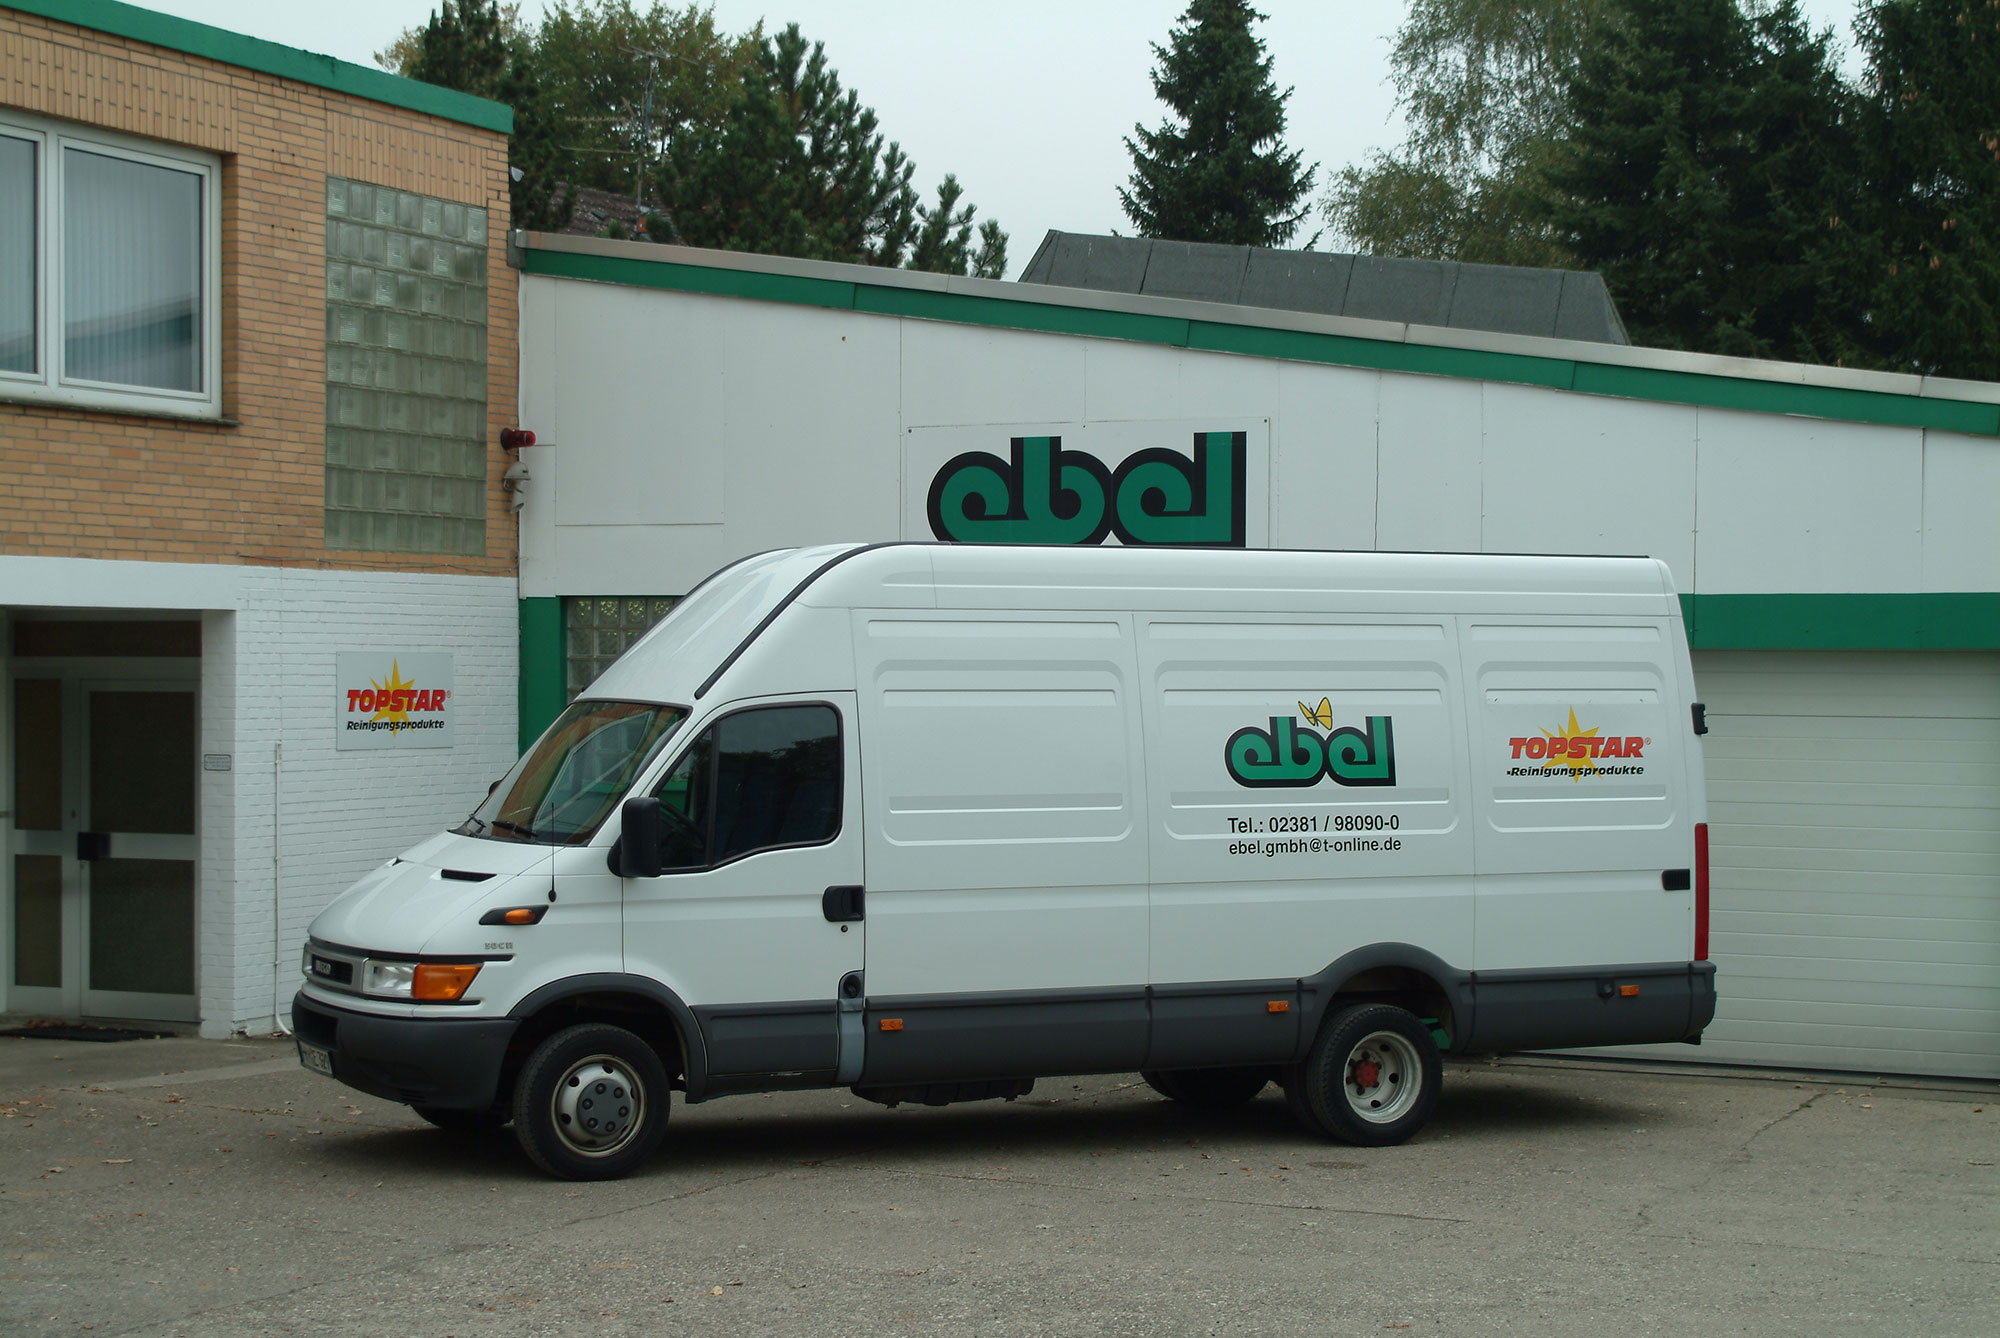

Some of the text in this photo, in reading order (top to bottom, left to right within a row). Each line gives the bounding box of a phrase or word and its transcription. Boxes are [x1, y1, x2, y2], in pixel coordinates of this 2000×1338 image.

[347, 719, 445, 731] Reinigungsprodukte
[1228, 814, 1399, 833] Tel.: 02381 / 98090-0
[1229, 837, 1402, 857] ebel.gmbh@t-online.de
